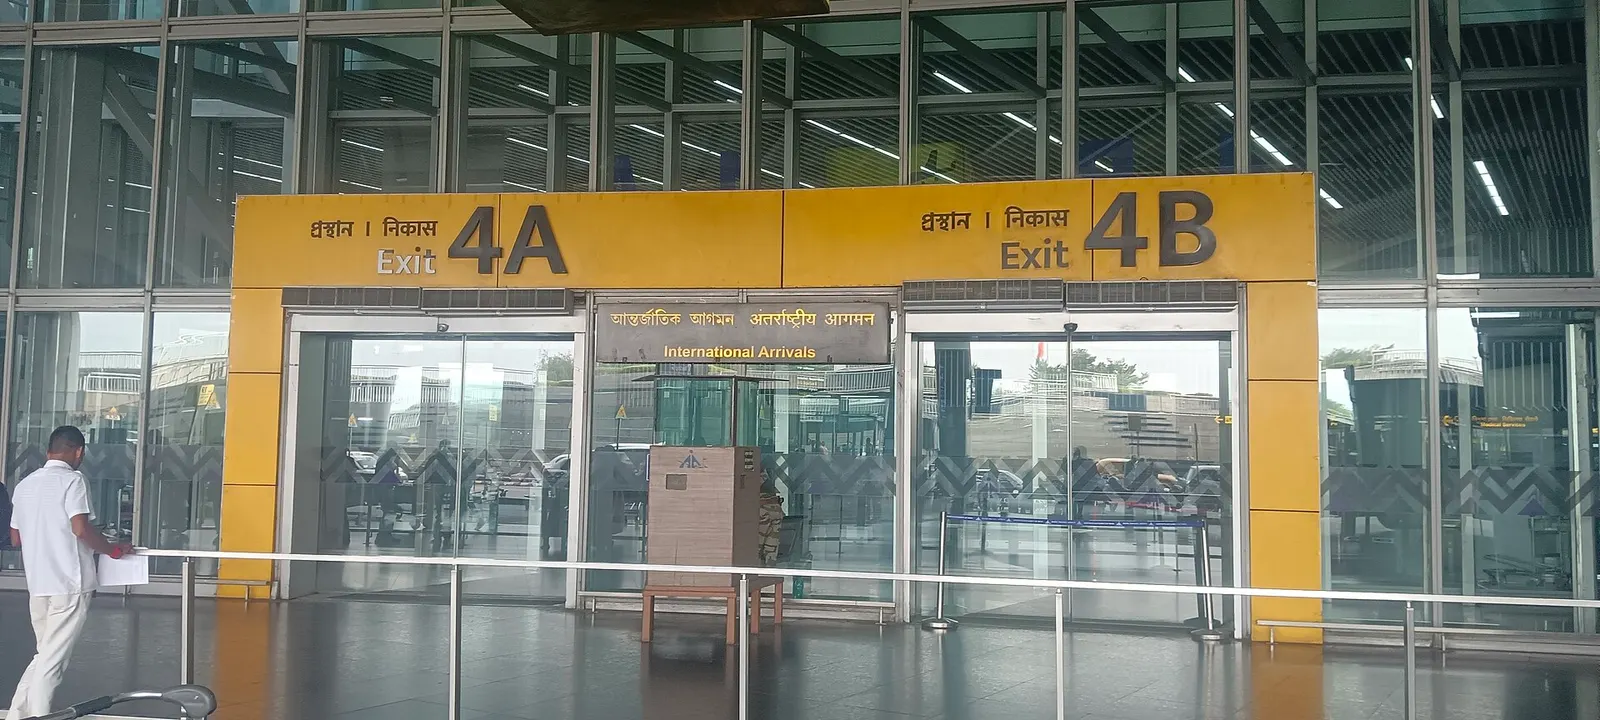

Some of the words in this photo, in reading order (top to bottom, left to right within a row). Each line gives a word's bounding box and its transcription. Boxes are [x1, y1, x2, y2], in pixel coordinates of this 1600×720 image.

[310, 219, 355, 239] প্রস্থান
[383, 216, 438, 237] निकास
[921, 211, 972, 232] প্রস্থান
[1004, 205, 1070, 228] निकास
[1084, 190, 1217, 268] 4B
[448, 204, 568, 275] 4A
[1001, 237, 1070, 270] Exit
[377, 246, 437, 275] Exit
[610, 308, 681, 327] আন্তর্জাতিক
[689, 311, 735, 326] আগমন
[749, 308, 817, 328] अंतर्राष्ट्रीय
[824, 312, 875, 326] आगमन
[663, 345, 755, 359] International
[757, 345, 817, 359] Arrivals
